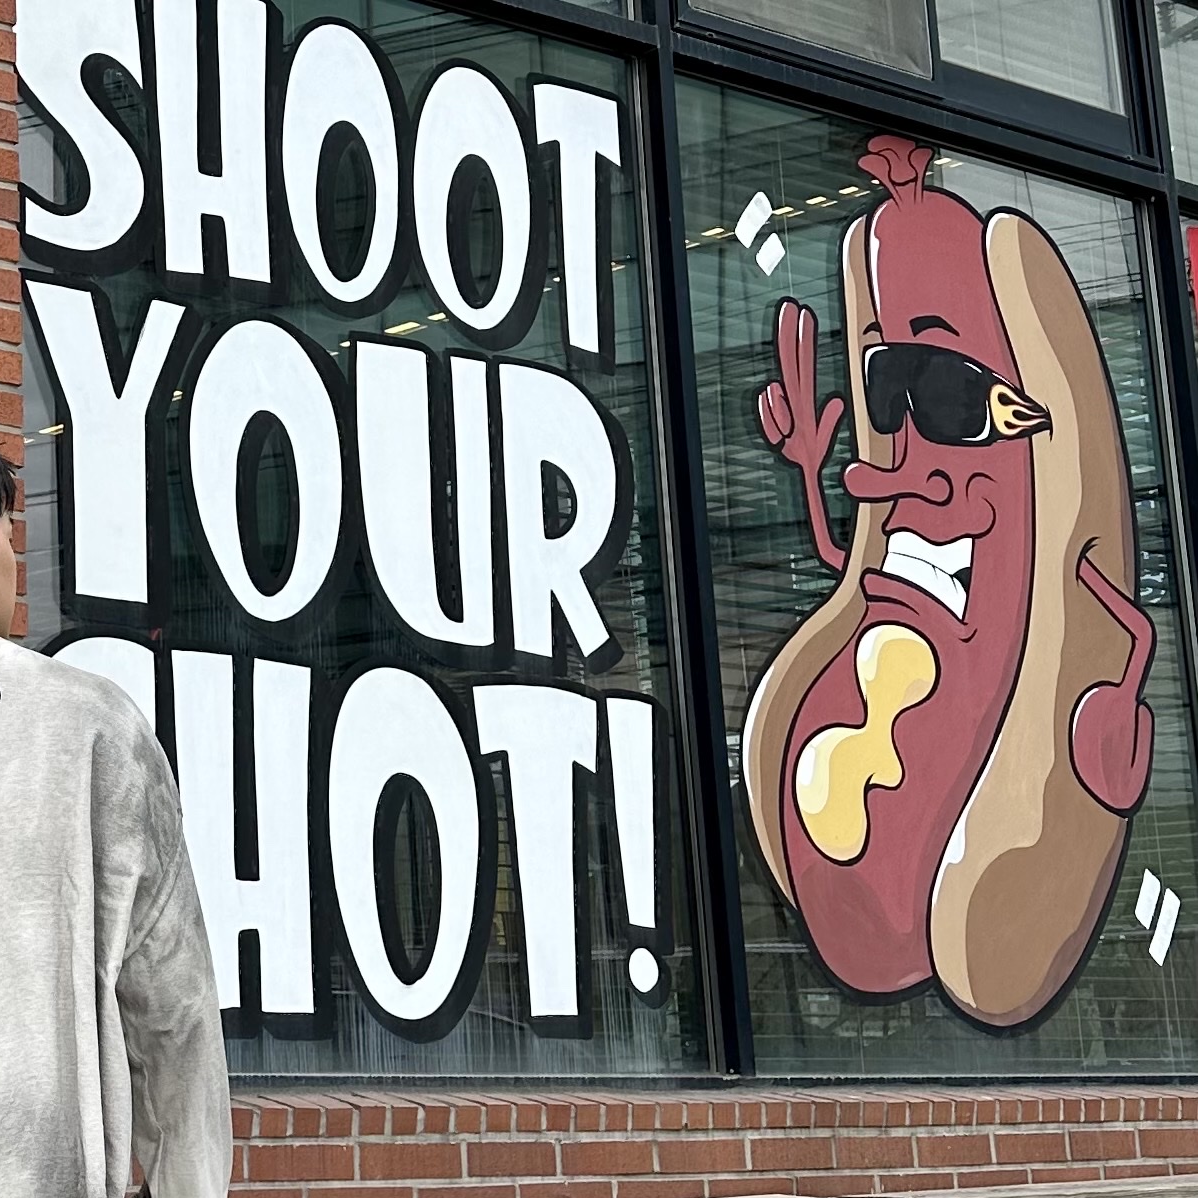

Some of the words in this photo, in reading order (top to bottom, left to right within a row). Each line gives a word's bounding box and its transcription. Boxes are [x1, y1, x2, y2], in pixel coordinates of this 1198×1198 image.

[15, 0, 621, 354] SHOOT
[25, 279, 617, 658] YOUR
[52, 637, 659, 1021] HOT!
